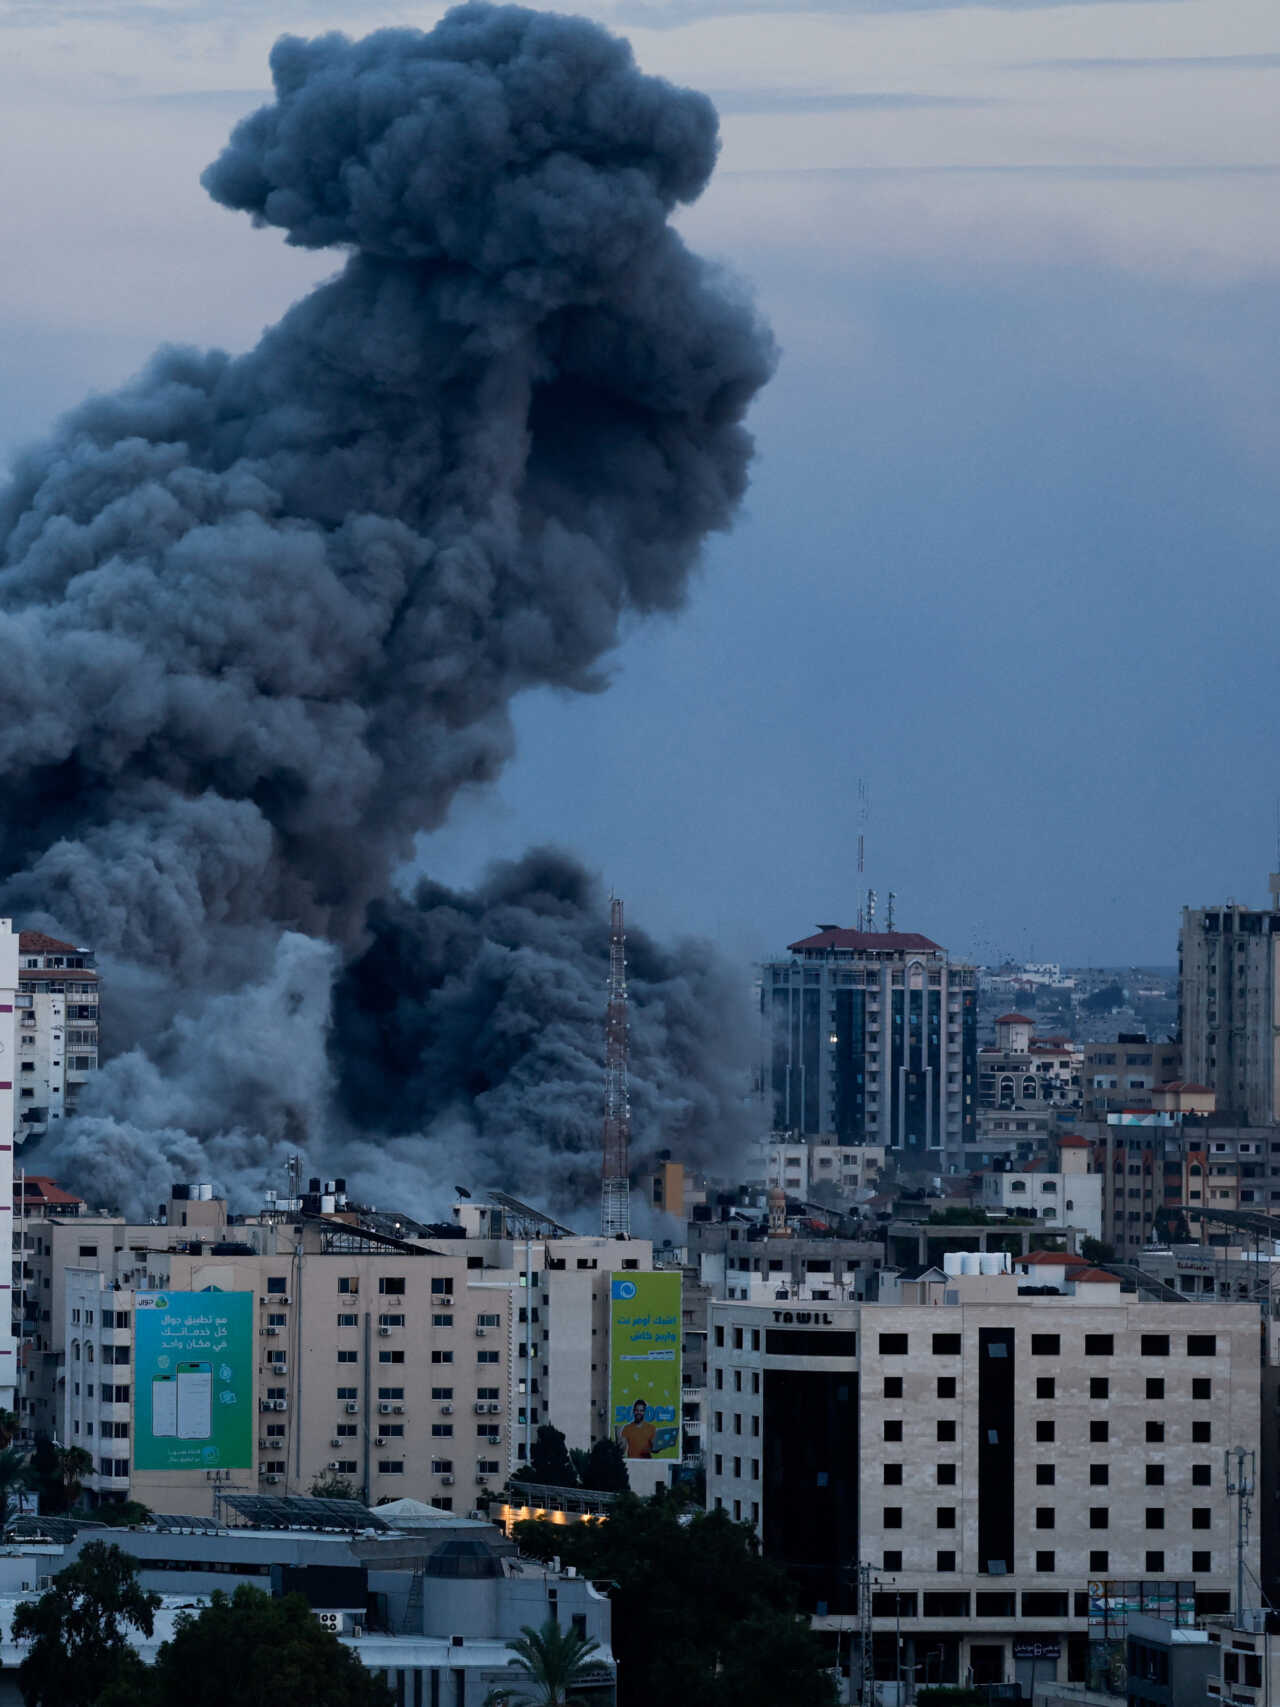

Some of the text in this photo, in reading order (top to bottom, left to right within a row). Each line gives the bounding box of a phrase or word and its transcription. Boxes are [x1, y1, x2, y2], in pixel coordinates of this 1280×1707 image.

[161, 1315, 228, 1326] مع تطبيق جوال
[773, 1311, 832, 1324] TAWIL
[215, 1328, 228, 1336] كل
[161, 1340, 183, 1349] واحد
[186, 1339, 211, 1350] مكان
